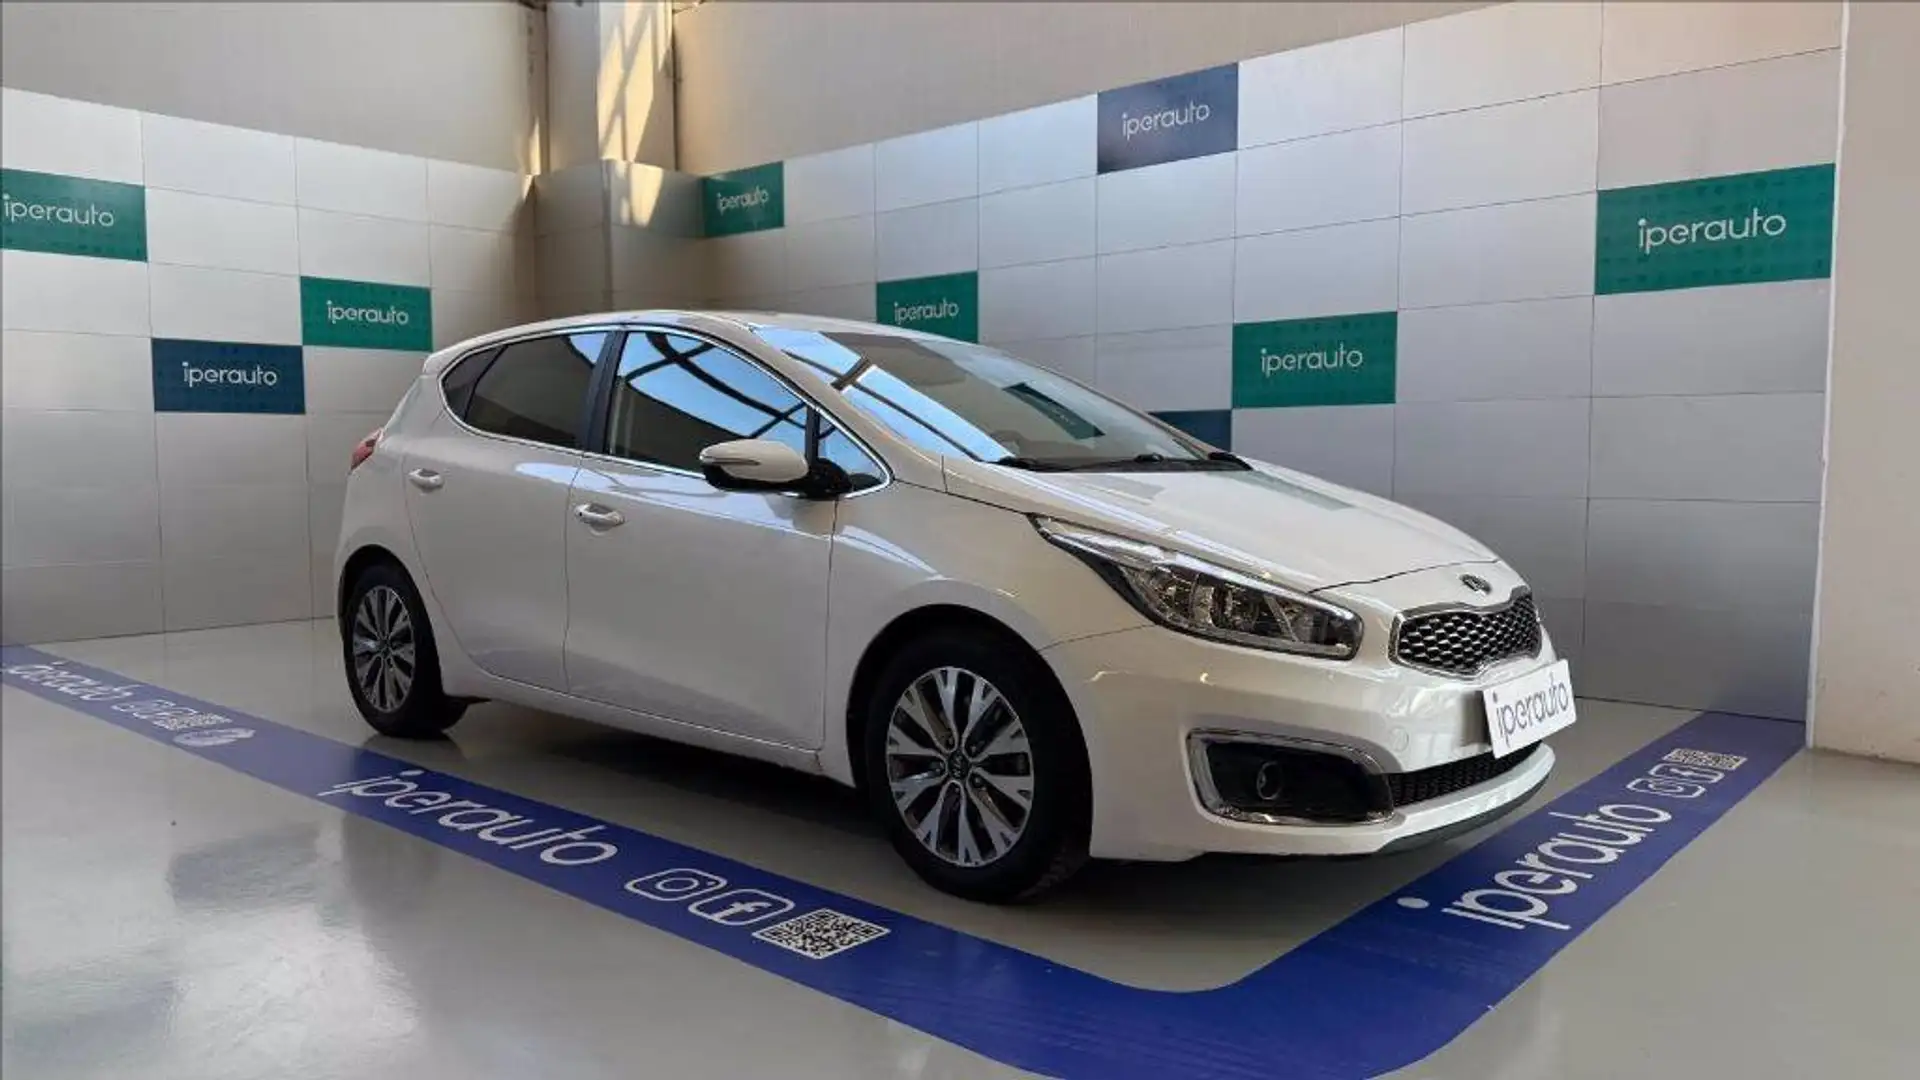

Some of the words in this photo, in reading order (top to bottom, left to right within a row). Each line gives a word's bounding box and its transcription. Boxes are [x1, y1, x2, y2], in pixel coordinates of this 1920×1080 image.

[1123, 99, 1210, 140] iperauto
[2, 193, 114, 227] iperauto
[717, 185, 769, 216] iperauto
[1637, 207, 1787, 254] iperauto
[327, 300, 410, 326] iperauto
[893, 298, 959, 325] iperauto
[182, 361, 277, 387] iperauto
[1260, 344, 1363, 376] iperauto
[1492, 673, 1571, 746] iperauto
[317, 769, 619, 866] iperauto
[1397, 803, 1673, 930] iperauto
